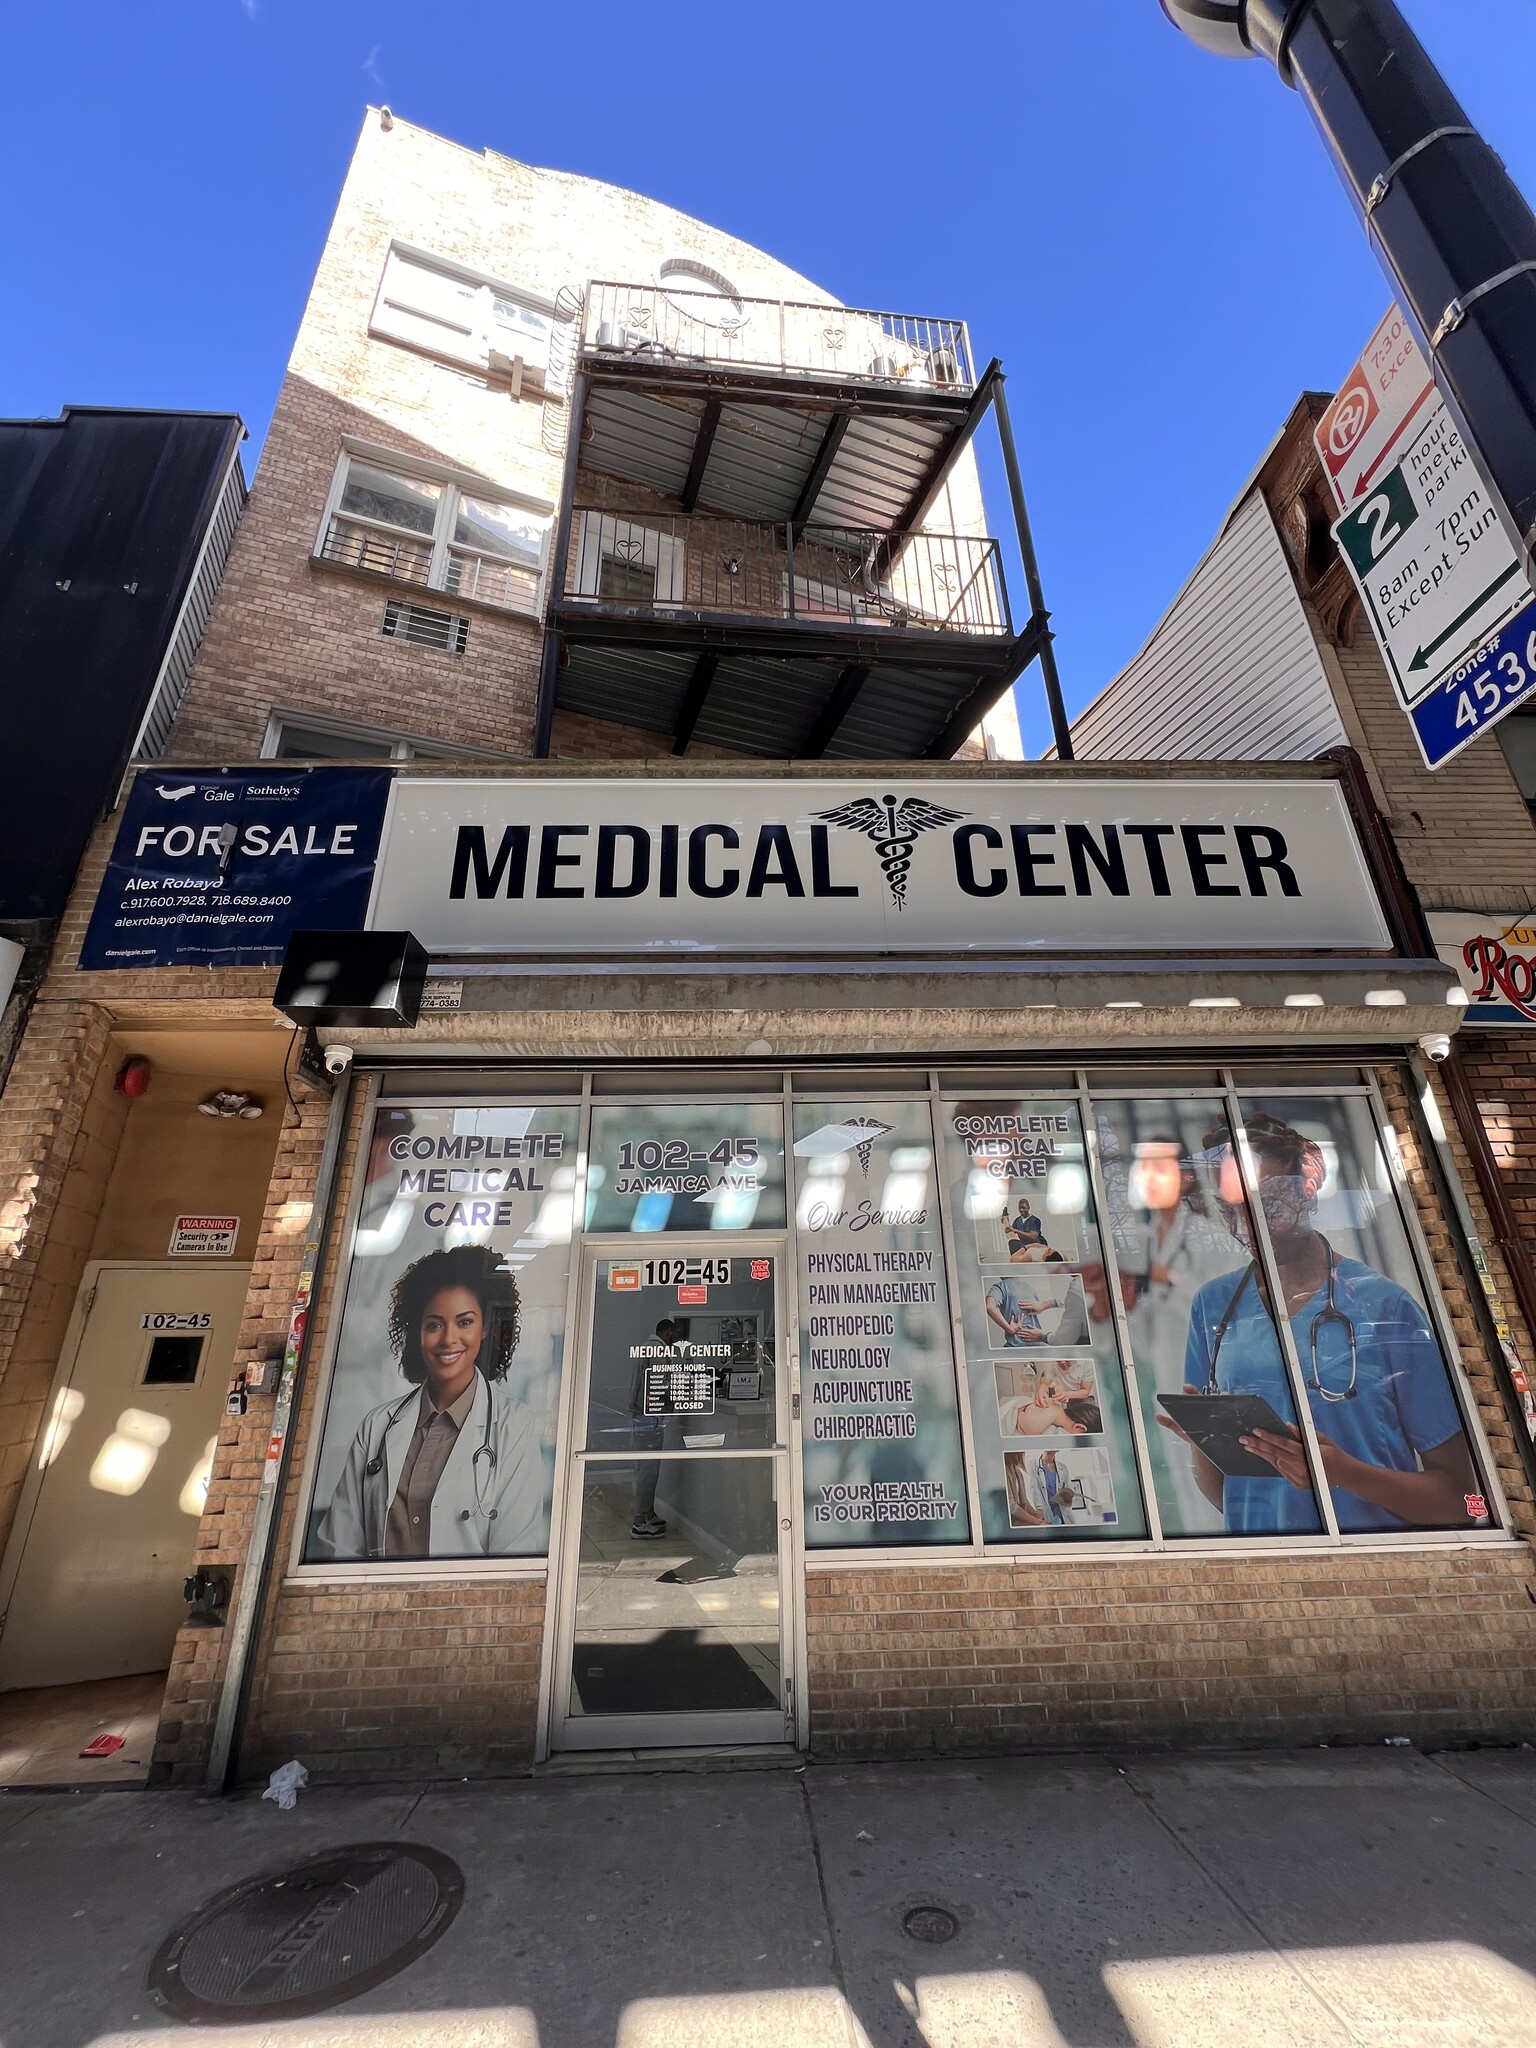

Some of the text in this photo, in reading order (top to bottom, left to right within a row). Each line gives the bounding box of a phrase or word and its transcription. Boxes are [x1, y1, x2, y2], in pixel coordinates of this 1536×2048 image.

[1410, 419, 1446, 470] hour
[1418, 432, 1460, 487] mete
[1424, 445, 1468, 508] parki
[1358, 493, 1401, 559] 2
[1379, 558, 1419, 605] 8am
[1435, 490, 1481, 541] 7pm
[1386, 507, 1498, 629] Except Sun
[204, 785, 300, 801] Gale Sotheby's
[135, 825, 358, 857] FOR SALE
[447, 824, 1303, 899] MEDICAL CENTER
[124, 877, 224, 891] Alex Robayo
[211, 895, 291, 907] 718.689.8400
[114, 913, 274, 928] alexrobayo@danielgale.com
[105, 948, 156, 957] danielgale.com
[953, 1116, 1070, 1135] COMPLETE
[389, 1133, 564, 1161] COMPLETE
[618, 1138, 759, 1171] 102-45
[966, 1138, 1062, 1157] MEDICAL
[399, 1166, 544, 1194] MEDICAL
[987, 1160, 1047, 1179] CARE
[615, 1175, 712, 1195] JAMAICA
[182, 1219, 234, 1229] WARNING
[424, 1200, 513, 1228] CARE
[807, 1199, 929, 1233] Our Services
[176, 1242, 228, 1251] Cameras In Use
[179, 1232, 209, 1242] Security
[645, 1259, 729, 1285] 102-45
[807, 1250, 933, 1275] PHYSICAL THERAPY
[808, 1281, 937, 1306] PAIN MANAGEMENT
[141, 1314, 211, 1329] 102-45
[809, 1314, 895, 1338] ORTHOPEDIC
[629, 1344, 731, 1358] MEDICAL CENTER
[811, 1346, 891, 1371] NEUROLOGY
[652, 1363, 706, 1372] BUSINESS HOURS
[812, 1379, 913, 1405] ACUPUNCTURE
[674, 1402, 704, 1410] CLOSED
[813, 1412, 917, 1440] CHIROPRACTIC
[820, 1481, 946, 1502] YOUR HEALTH
[814, 1501, 959, 1522] IS OUR PRIORITY
